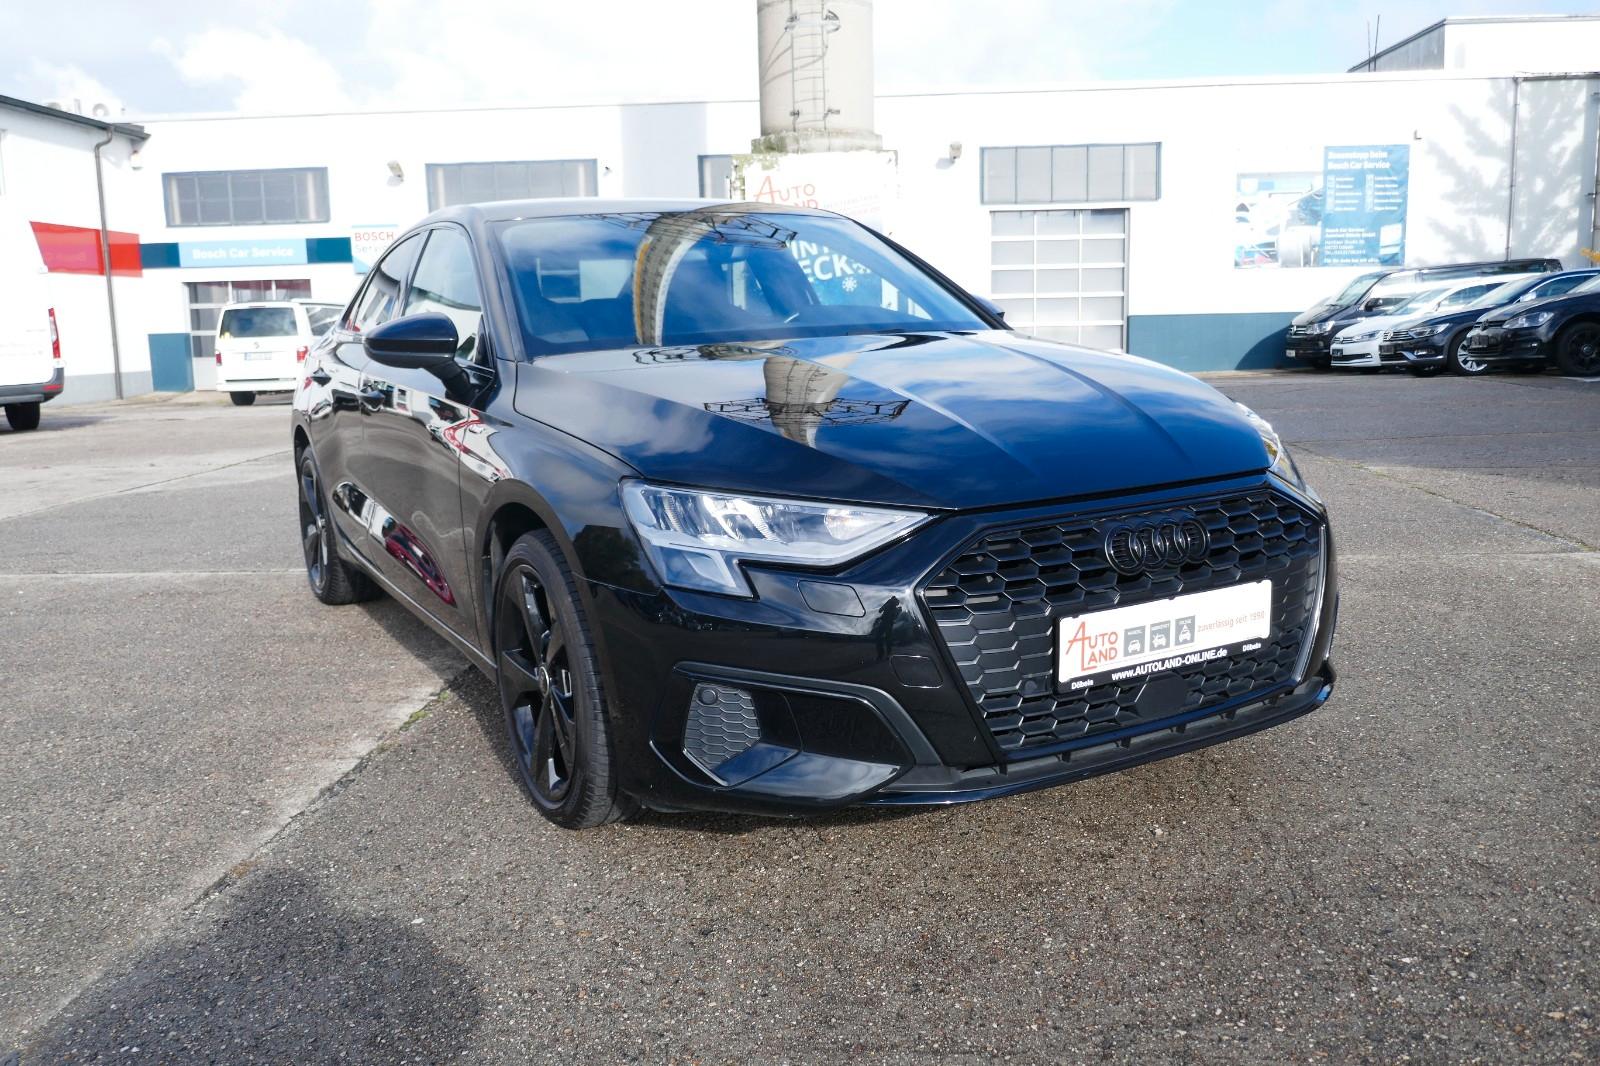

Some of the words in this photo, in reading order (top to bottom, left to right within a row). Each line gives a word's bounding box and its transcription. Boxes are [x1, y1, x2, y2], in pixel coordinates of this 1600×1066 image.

[354, 231, 394, 242] BOSCH
[192, 248, 227, 260] Bosch
[229, 248, 248, 258] Car
[251, 246, 295, 258] Service
[1235, 614, 1248, 627] seit
[1111, 648, 1228, 682] www.AUTOLAND-ONLINE.de
